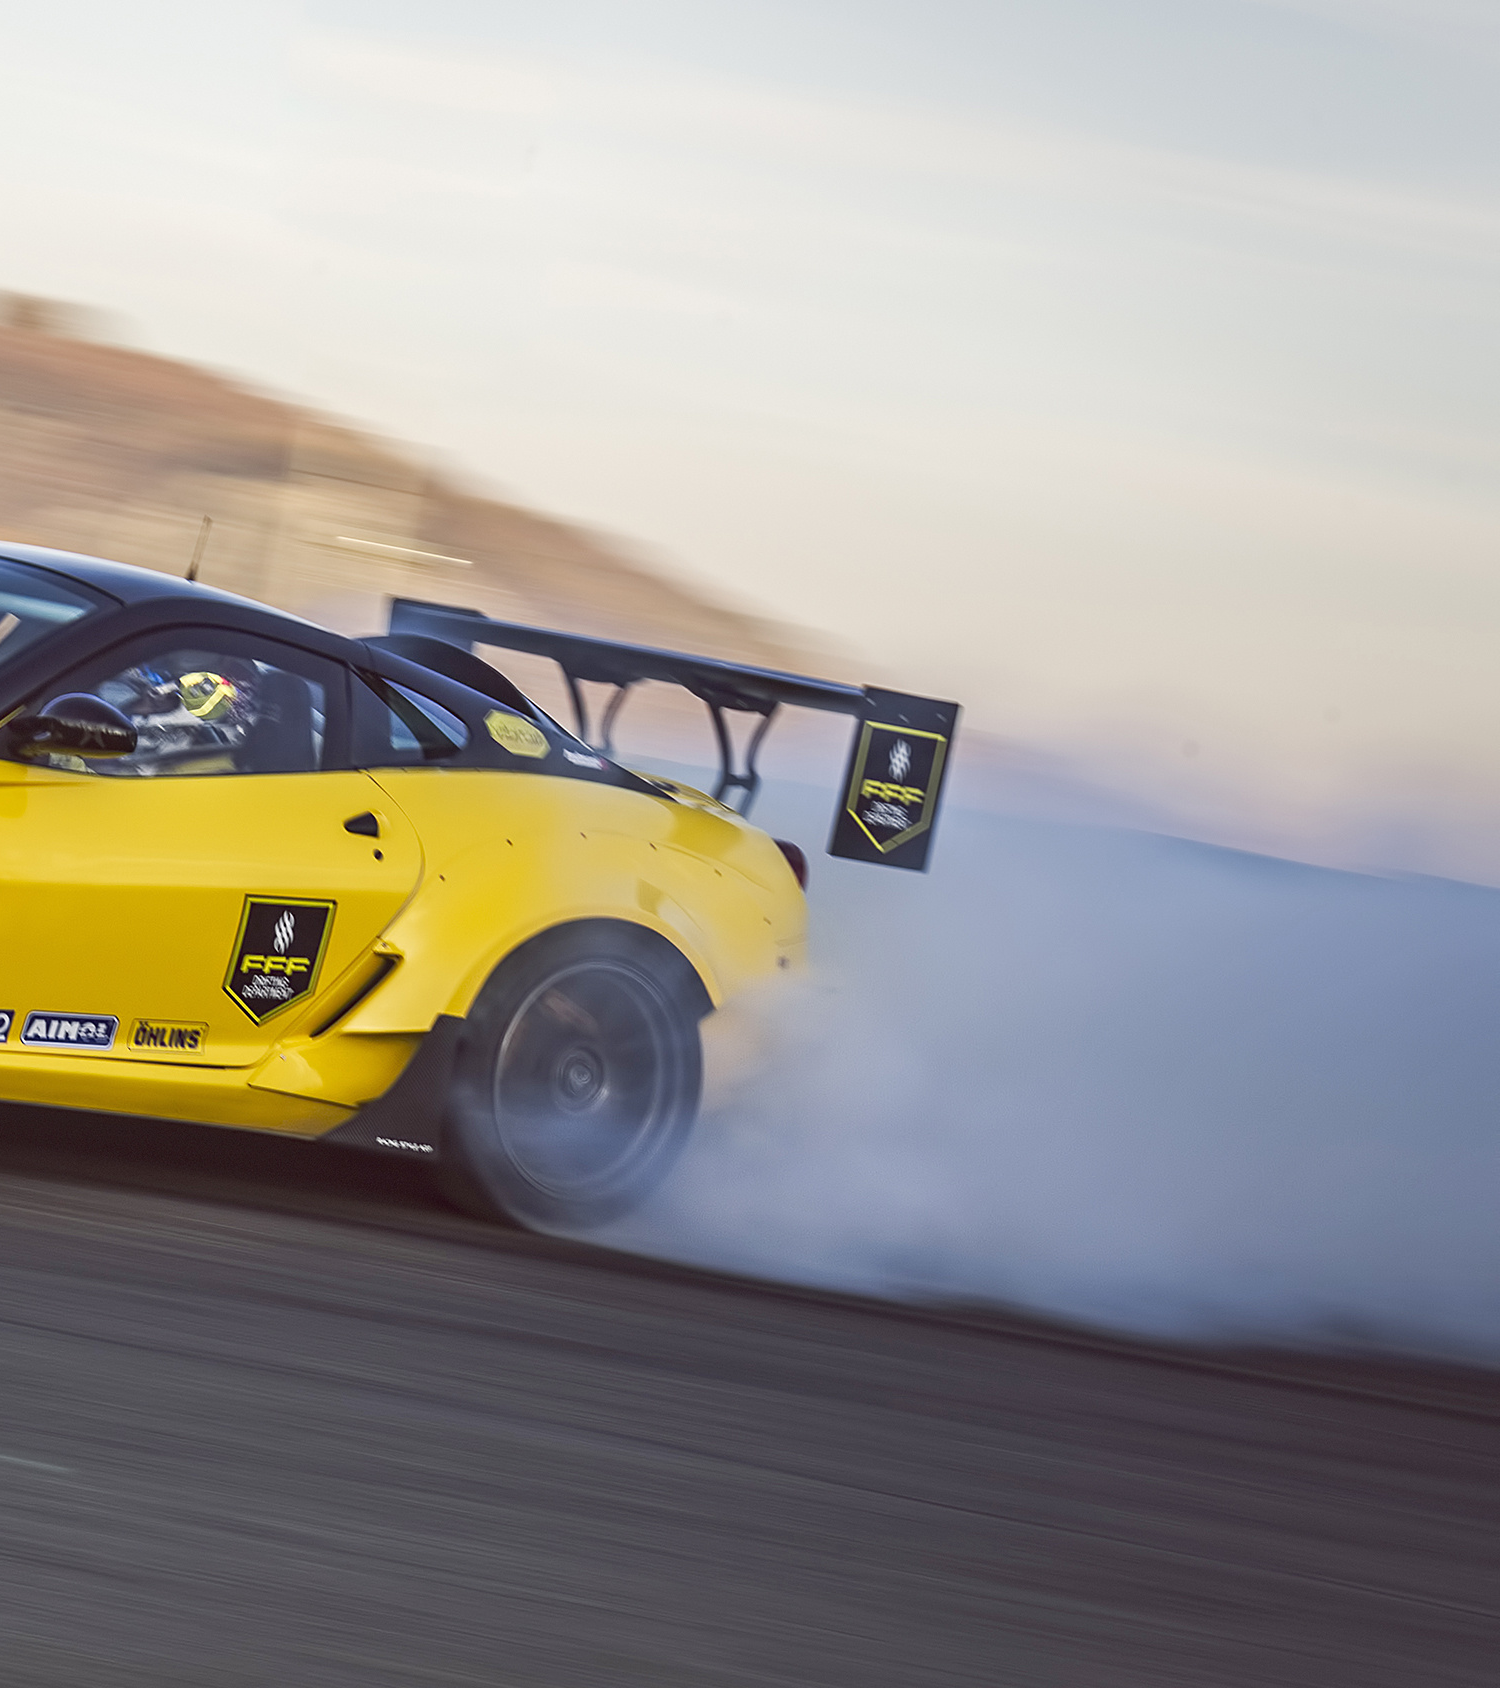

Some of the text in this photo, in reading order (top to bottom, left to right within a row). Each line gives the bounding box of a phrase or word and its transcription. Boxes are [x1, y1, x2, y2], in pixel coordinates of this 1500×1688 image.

[861, 778, 926, 806] FFF
[240, 954, 311, 976] FFF
[134, 1020, 202, 1050] ÖHLINS
